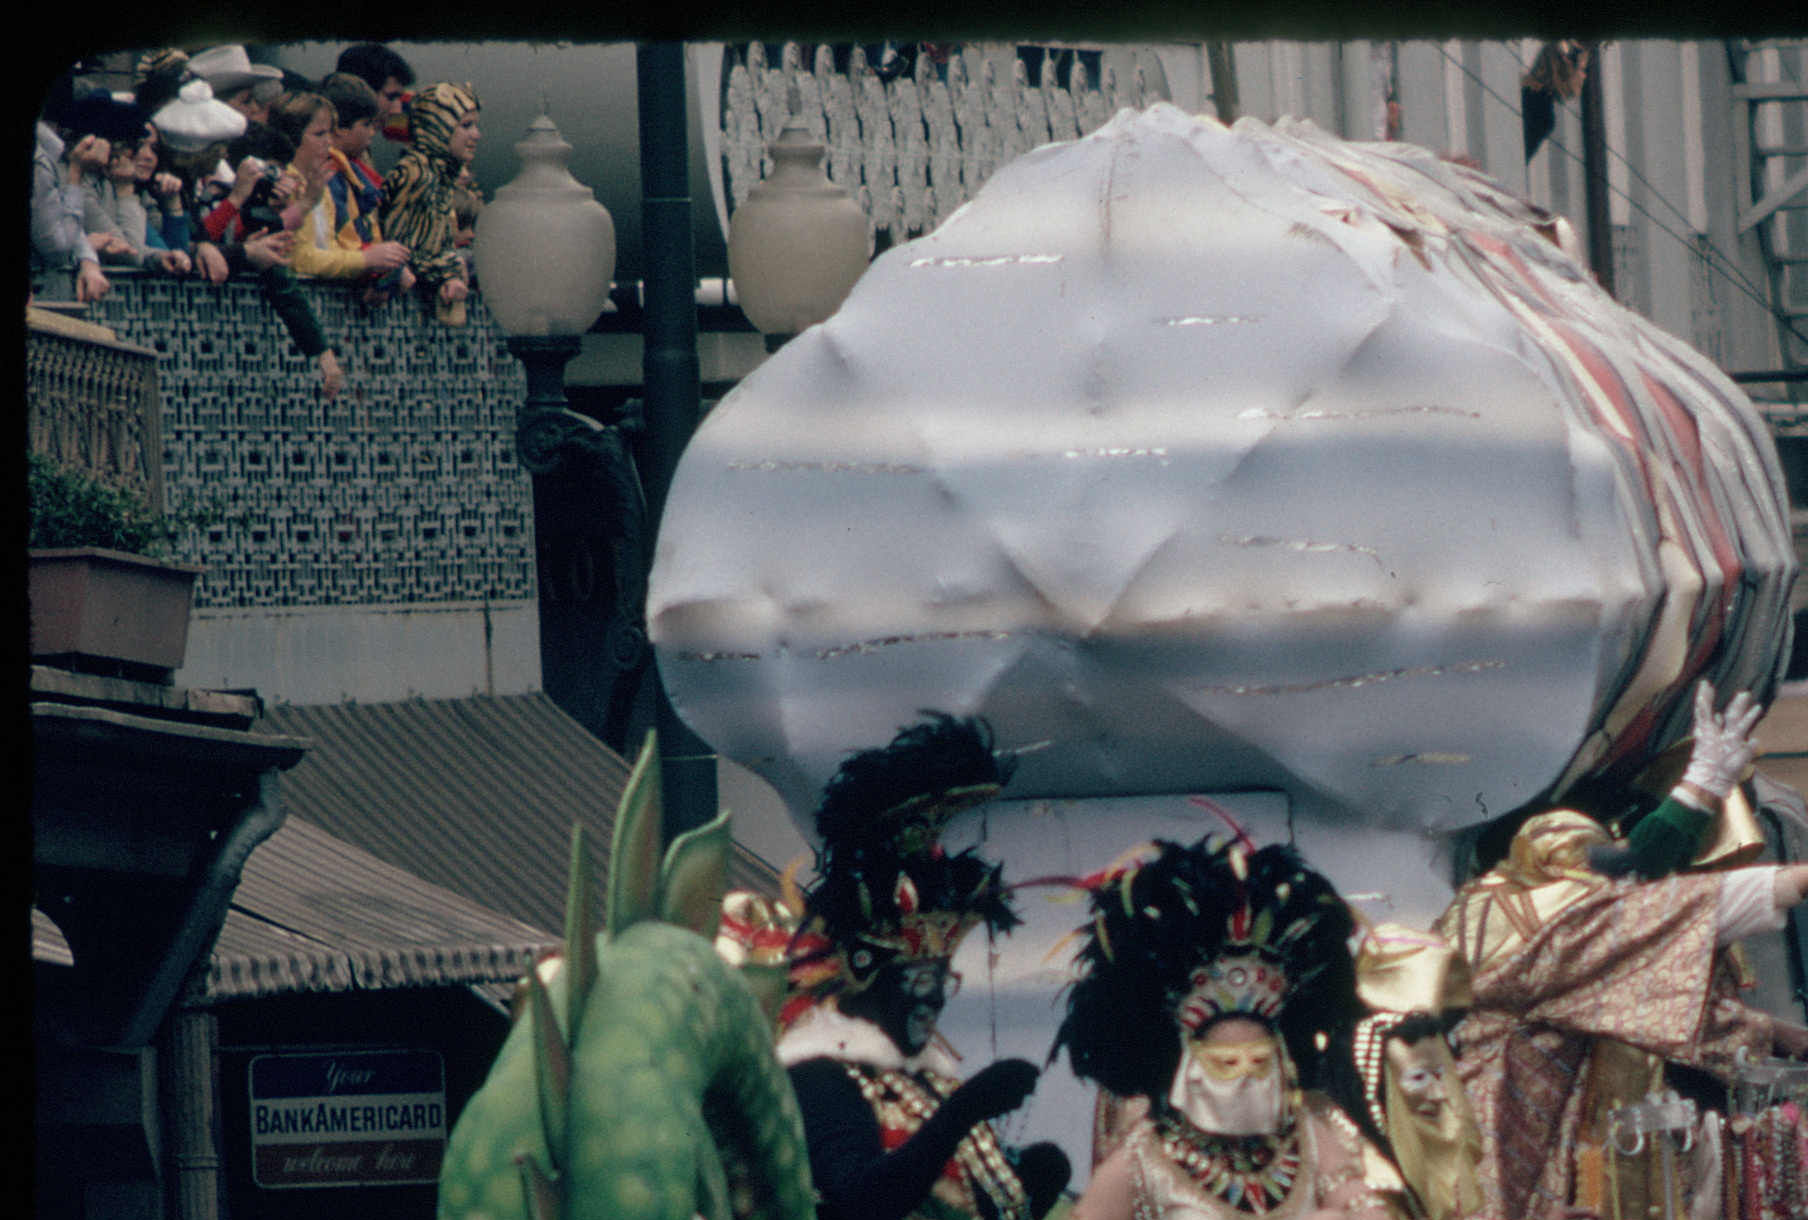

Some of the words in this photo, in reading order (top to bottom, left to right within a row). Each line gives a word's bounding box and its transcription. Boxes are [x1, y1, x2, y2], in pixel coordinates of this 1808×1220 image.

[322, 1058, 376, 1093] Your
[283, 1146, 361, 1174] welcome
[375, 1144, 417, 1170] here
